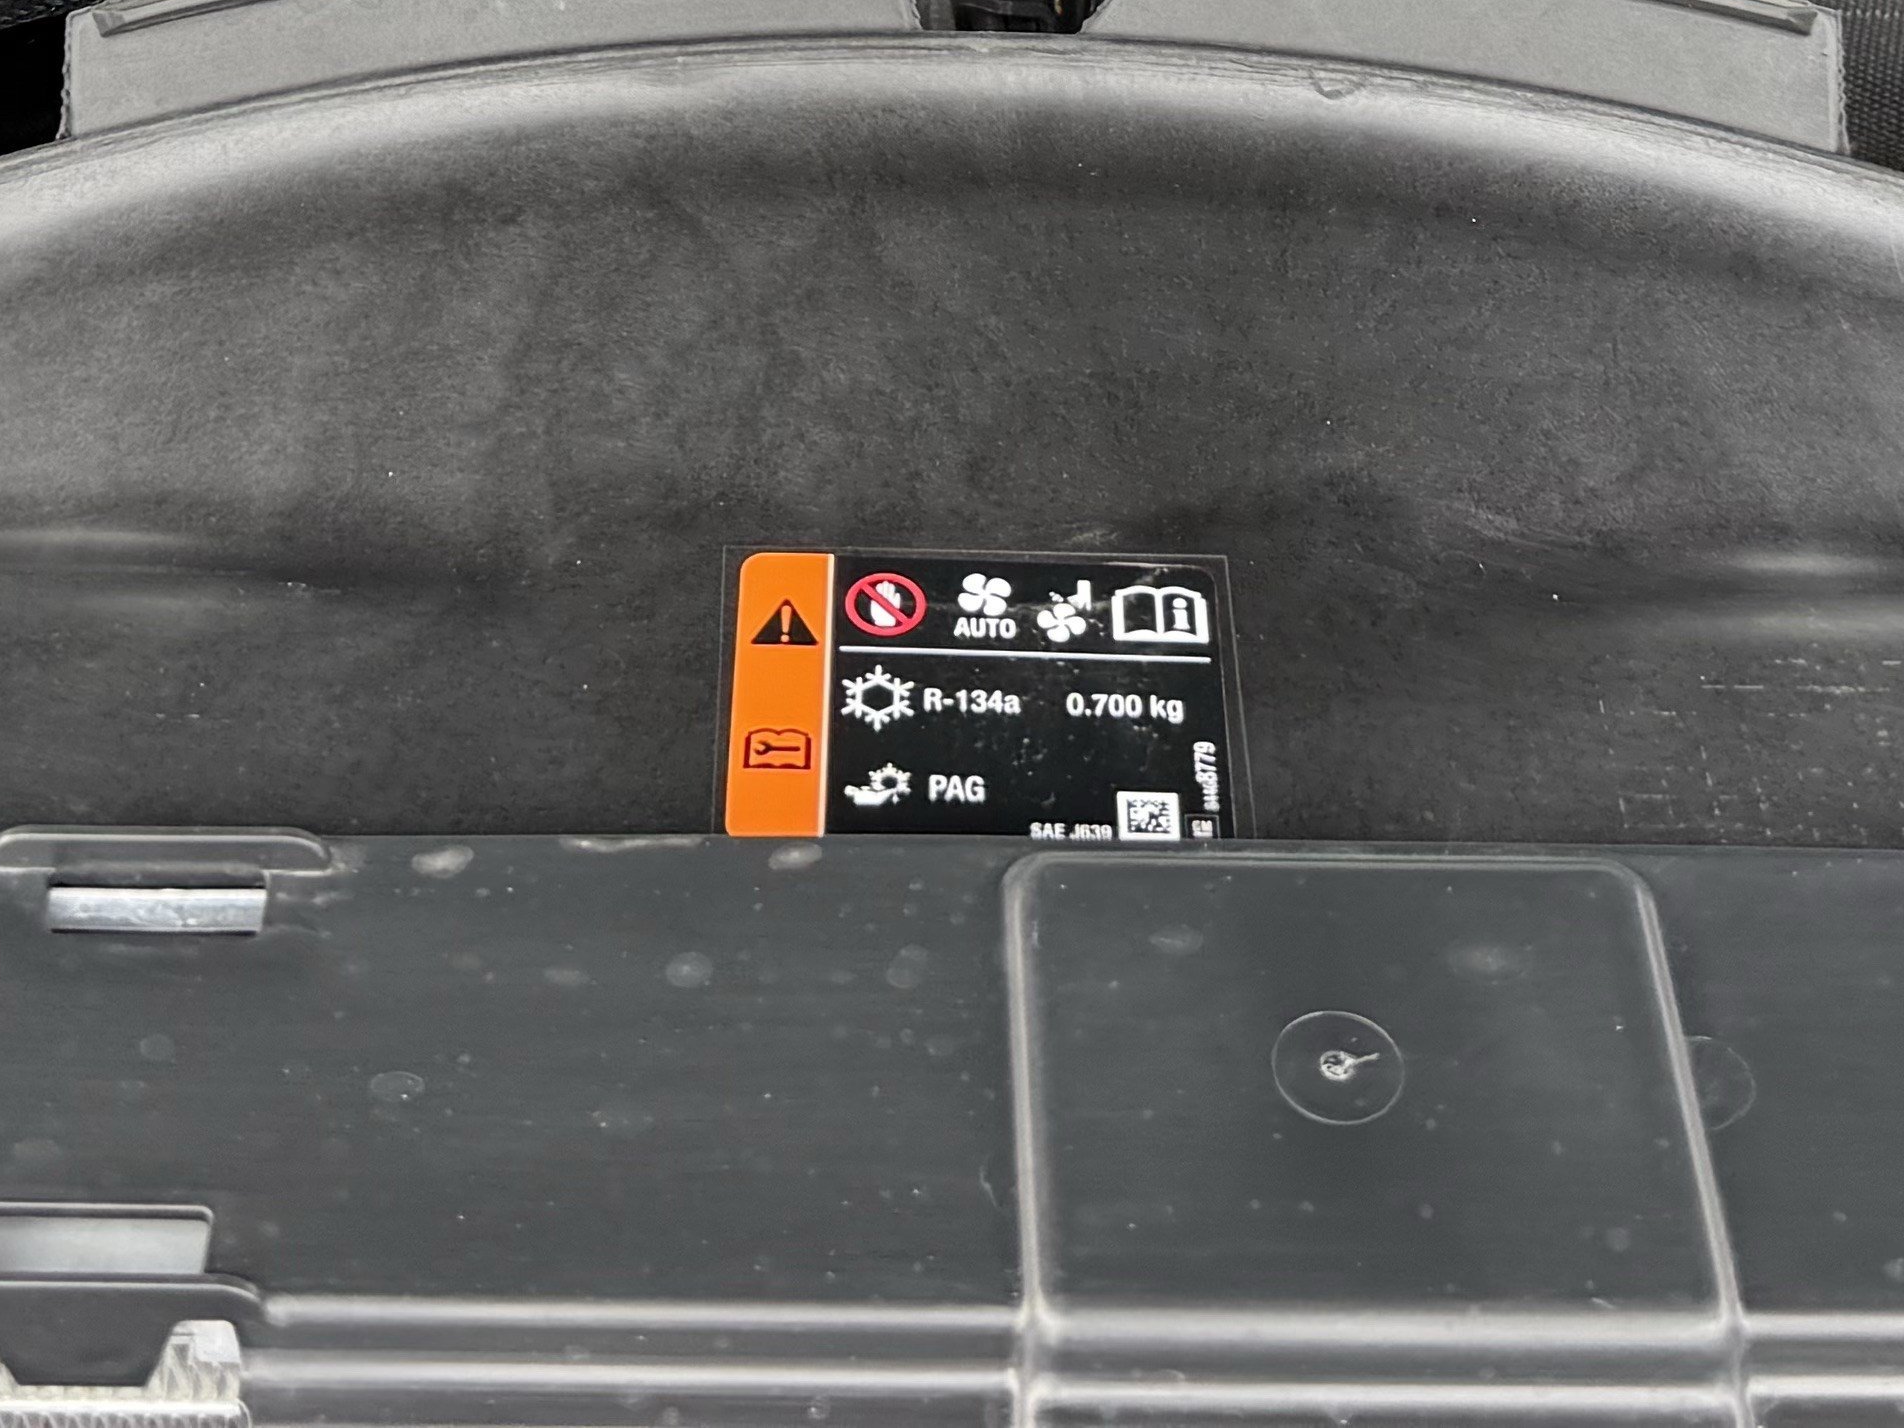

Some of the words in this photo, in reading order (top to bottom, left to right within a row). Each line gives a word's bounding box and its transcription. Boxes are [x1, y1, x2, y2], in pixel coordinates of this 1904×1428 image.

[953, 617, 1016, 640] AUTO
[923, 687, 1021, 715] R-134a
[1066, 693, 1142, 718] 0.700
[1150, 694, 1184, 724] kg
[928, 774, 985, 802] PAG
[1030, 822, 1066, 840] SAE
